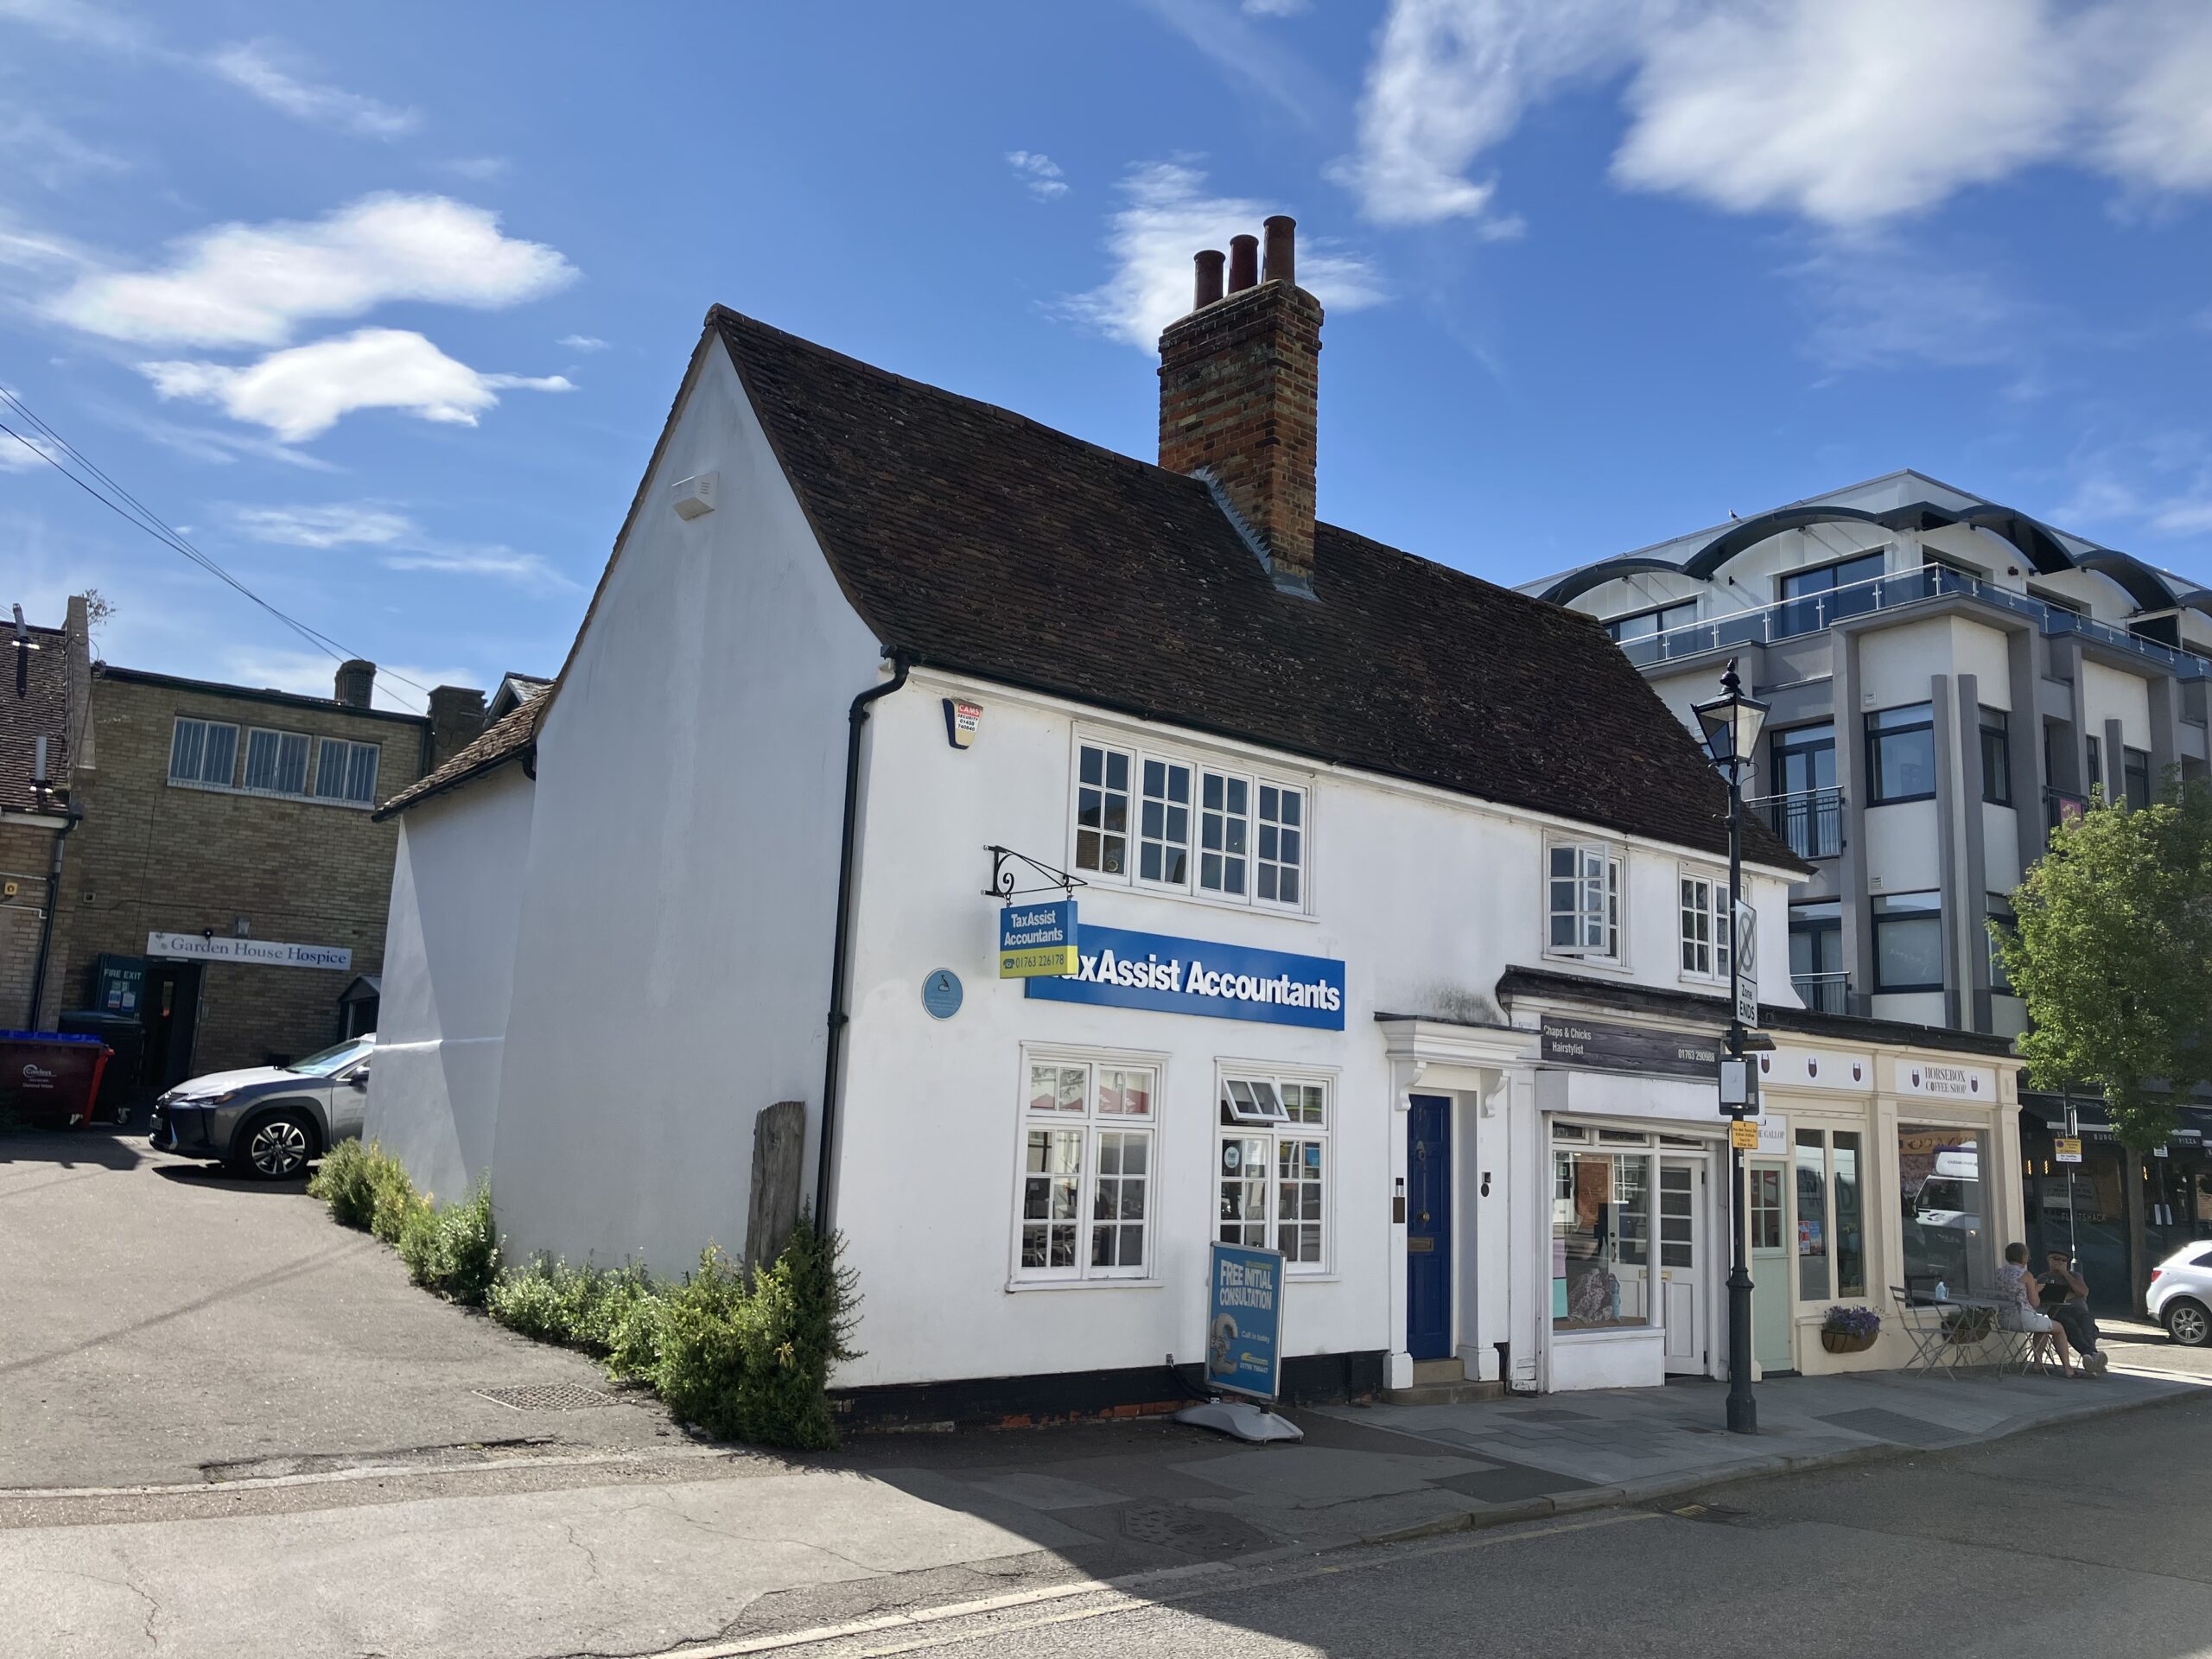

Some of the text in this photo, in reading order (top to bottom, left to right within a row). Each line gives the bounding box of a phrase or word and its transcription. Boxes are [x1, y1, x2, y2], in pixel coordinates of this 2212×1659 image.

[959, 704, 980, 715] CAMS
[1011, 910, 1056, 928] TaxAssist
[1004, 927, 1064, 946] Accountants
[171, 937, 346, 965] Garden House Hospice
[1015, 954, 1065, 969] 01763 226178
[104, 968, 142, 981] FIRE EXIT
[1185, 960, 1341, 1012] Accountants
[1741, 983, 1752, 1001] Zone
[1739, 1000, 1755, 1020] ENDS
[1543, 1025, 1592, 1041] Chaps & Chicks
[1552, 1041, 1584, 1056] Hairstylist
[1678, 1048, 1695, 1060] 01763
[1925, 1066, 1966, 1083] HORSEBOX
[1925, 1082, 1967, 1094] COFFEE SHOP
[1764, 1129, 1785, 1140] GALLOP
[1220, 1259, 1244, 1287] FREE
[1244, 1267, 1273, 1290] INITIAL
[1219, 1287, 1273, 1311] CONSULTATION
